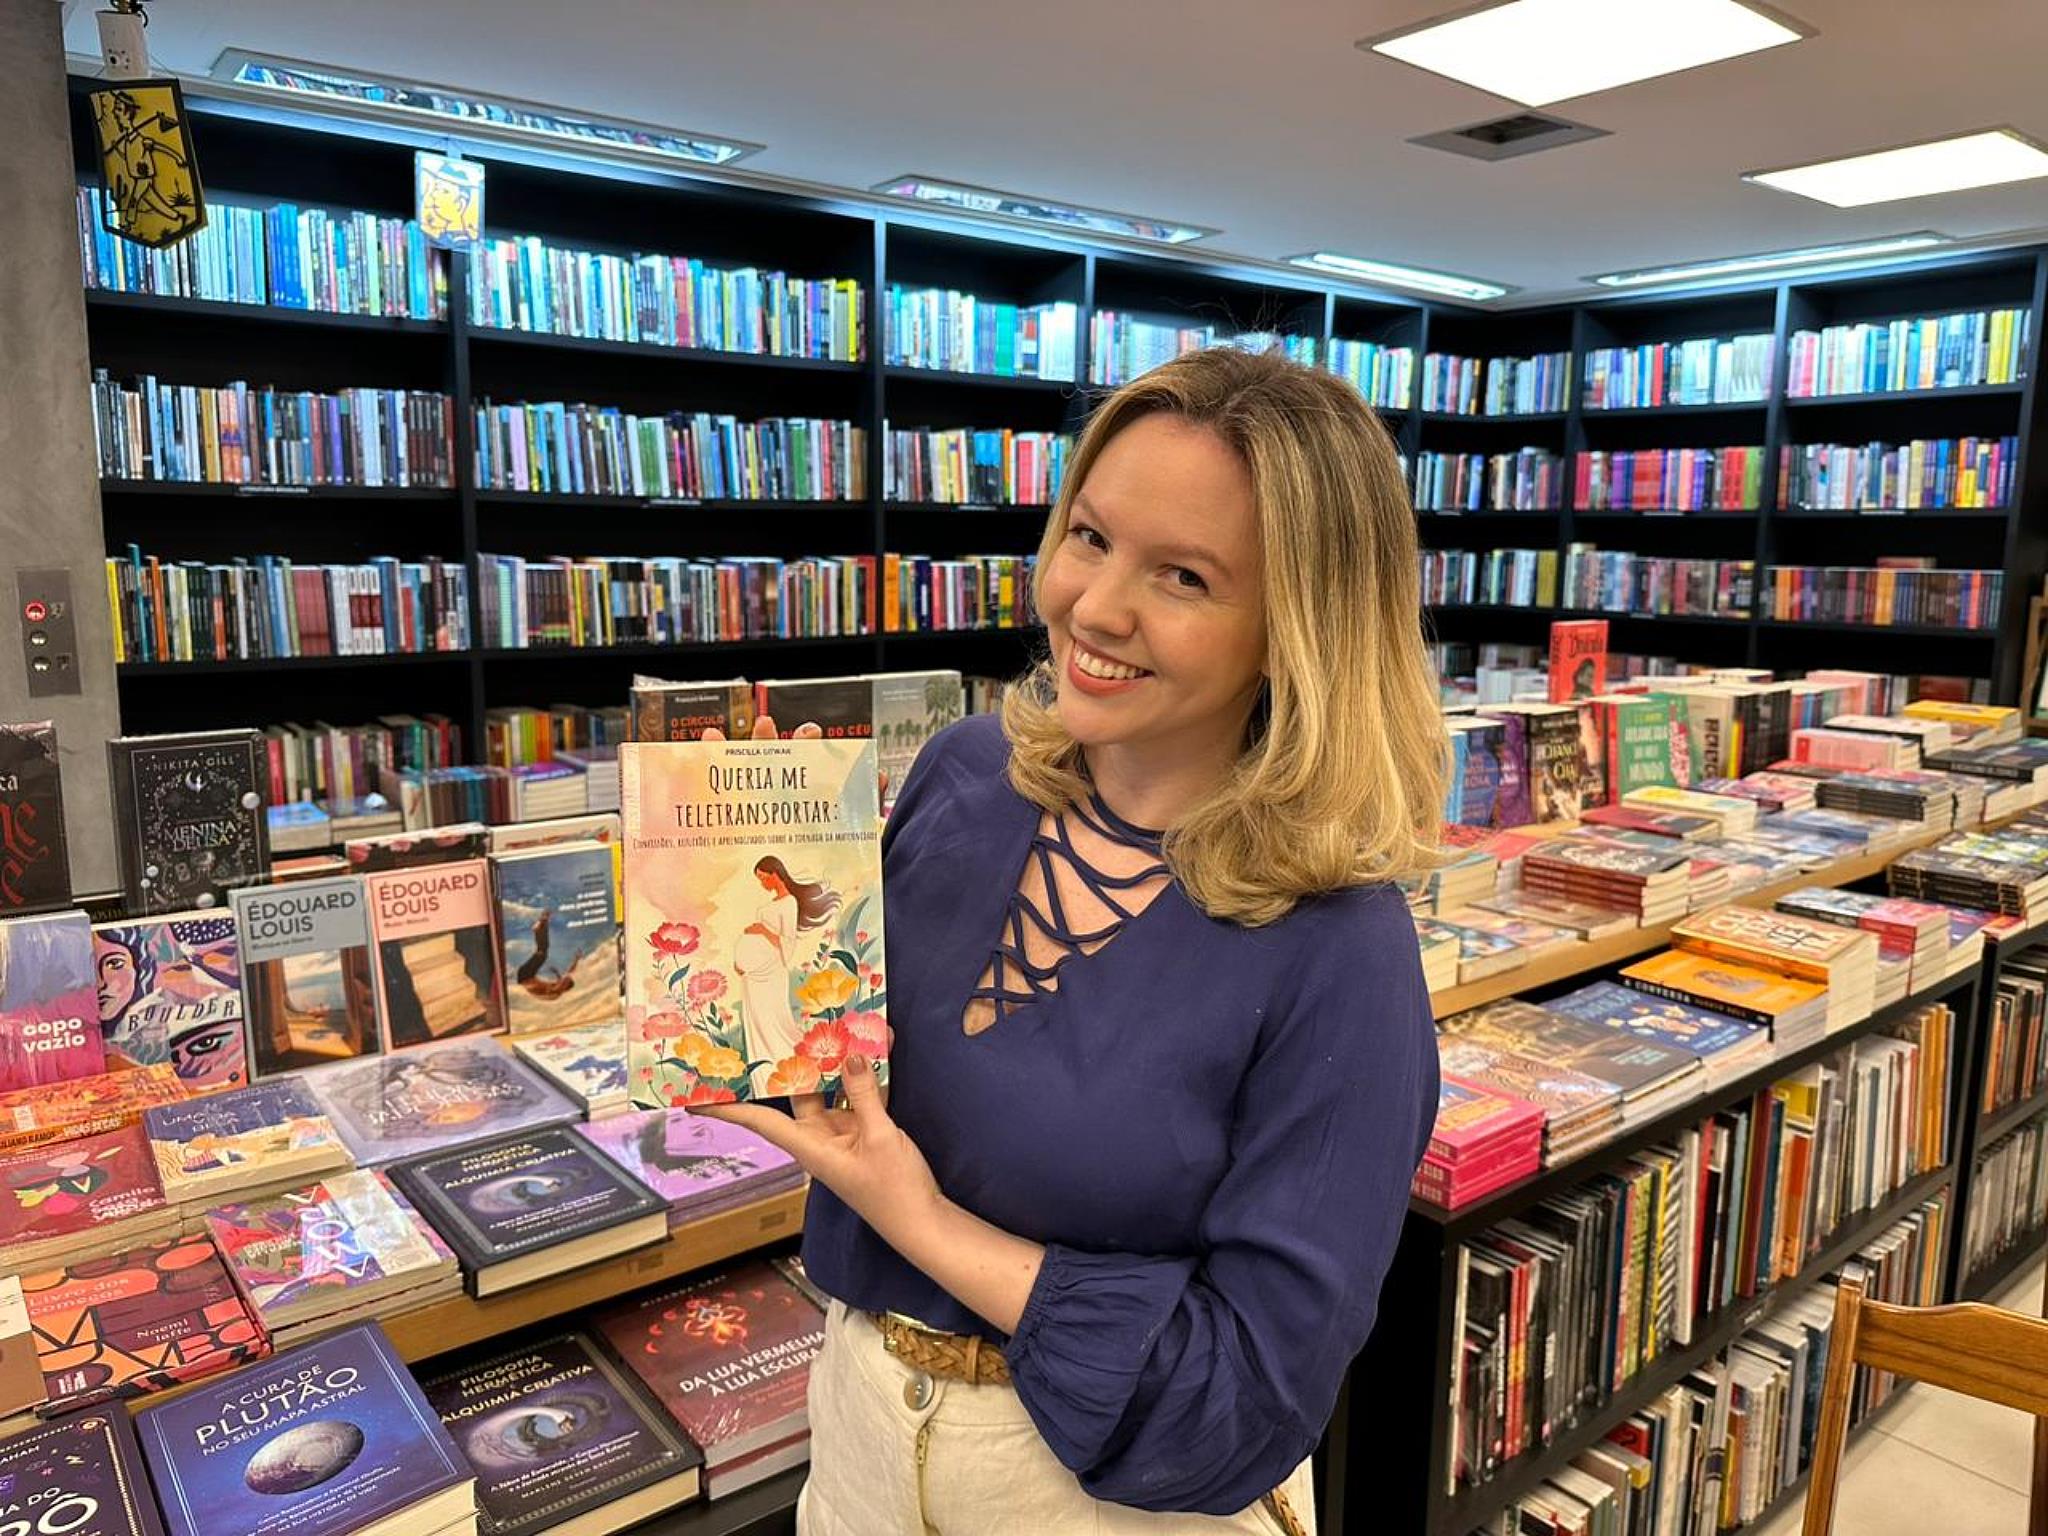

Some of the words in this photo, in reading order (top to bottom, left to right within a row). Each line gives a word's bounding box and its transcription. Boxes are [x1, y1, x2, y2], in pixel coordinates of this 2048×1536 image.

[153, 759, 199, 771] NIKITA
[206, 756, 235, 767] GILL
[781, 765, 807, 790] ME
[675, 800, 839, 828] TELETRANSPORTAR:
[164, 820, 237, 841] MENINA
[379, 873, 479, 902] ÉDOUARD
[248, 890, 356, 922] ÉDOUARD
[381, 896, 441, 919] LOUIS
[250, 915, 314, 940] LOUIS
[22, 1017, 83, 1038] copo
[127, 998, 236, 1033] BOULDER
[22, 1032, 86, 1053] vazio
[460, 1354, 544, 1388] FILOSOFIA
[679, 1376, 709, 1393] DA
[706, 1362, 743, 1382] LUA
[741, 1330, 826, 1368] VERMELHA
[723, 1372, 761, 1391] LUA
[760, 1347, 822, 1377] ESCURA
[221, 1402, 236, 1415] A
[239, 1377, 296, 1405] CURA
[298, 1364, 324, 1380] DE
[440, 1390, 522, 1424] ALQUIMIA
[522, 1365, 595, 1394] CRIATIVA
[195, 1367, 358, 1446] PLUTÃO
[202, 1440, 230, 1457] NO
[231, 1427, 261, 1444] SEU
[263, 1407, 309, 1433] MAPA
[311, 1382, 367, 1412] ASTRAL
[27, 1487, 61, 1507] DO
